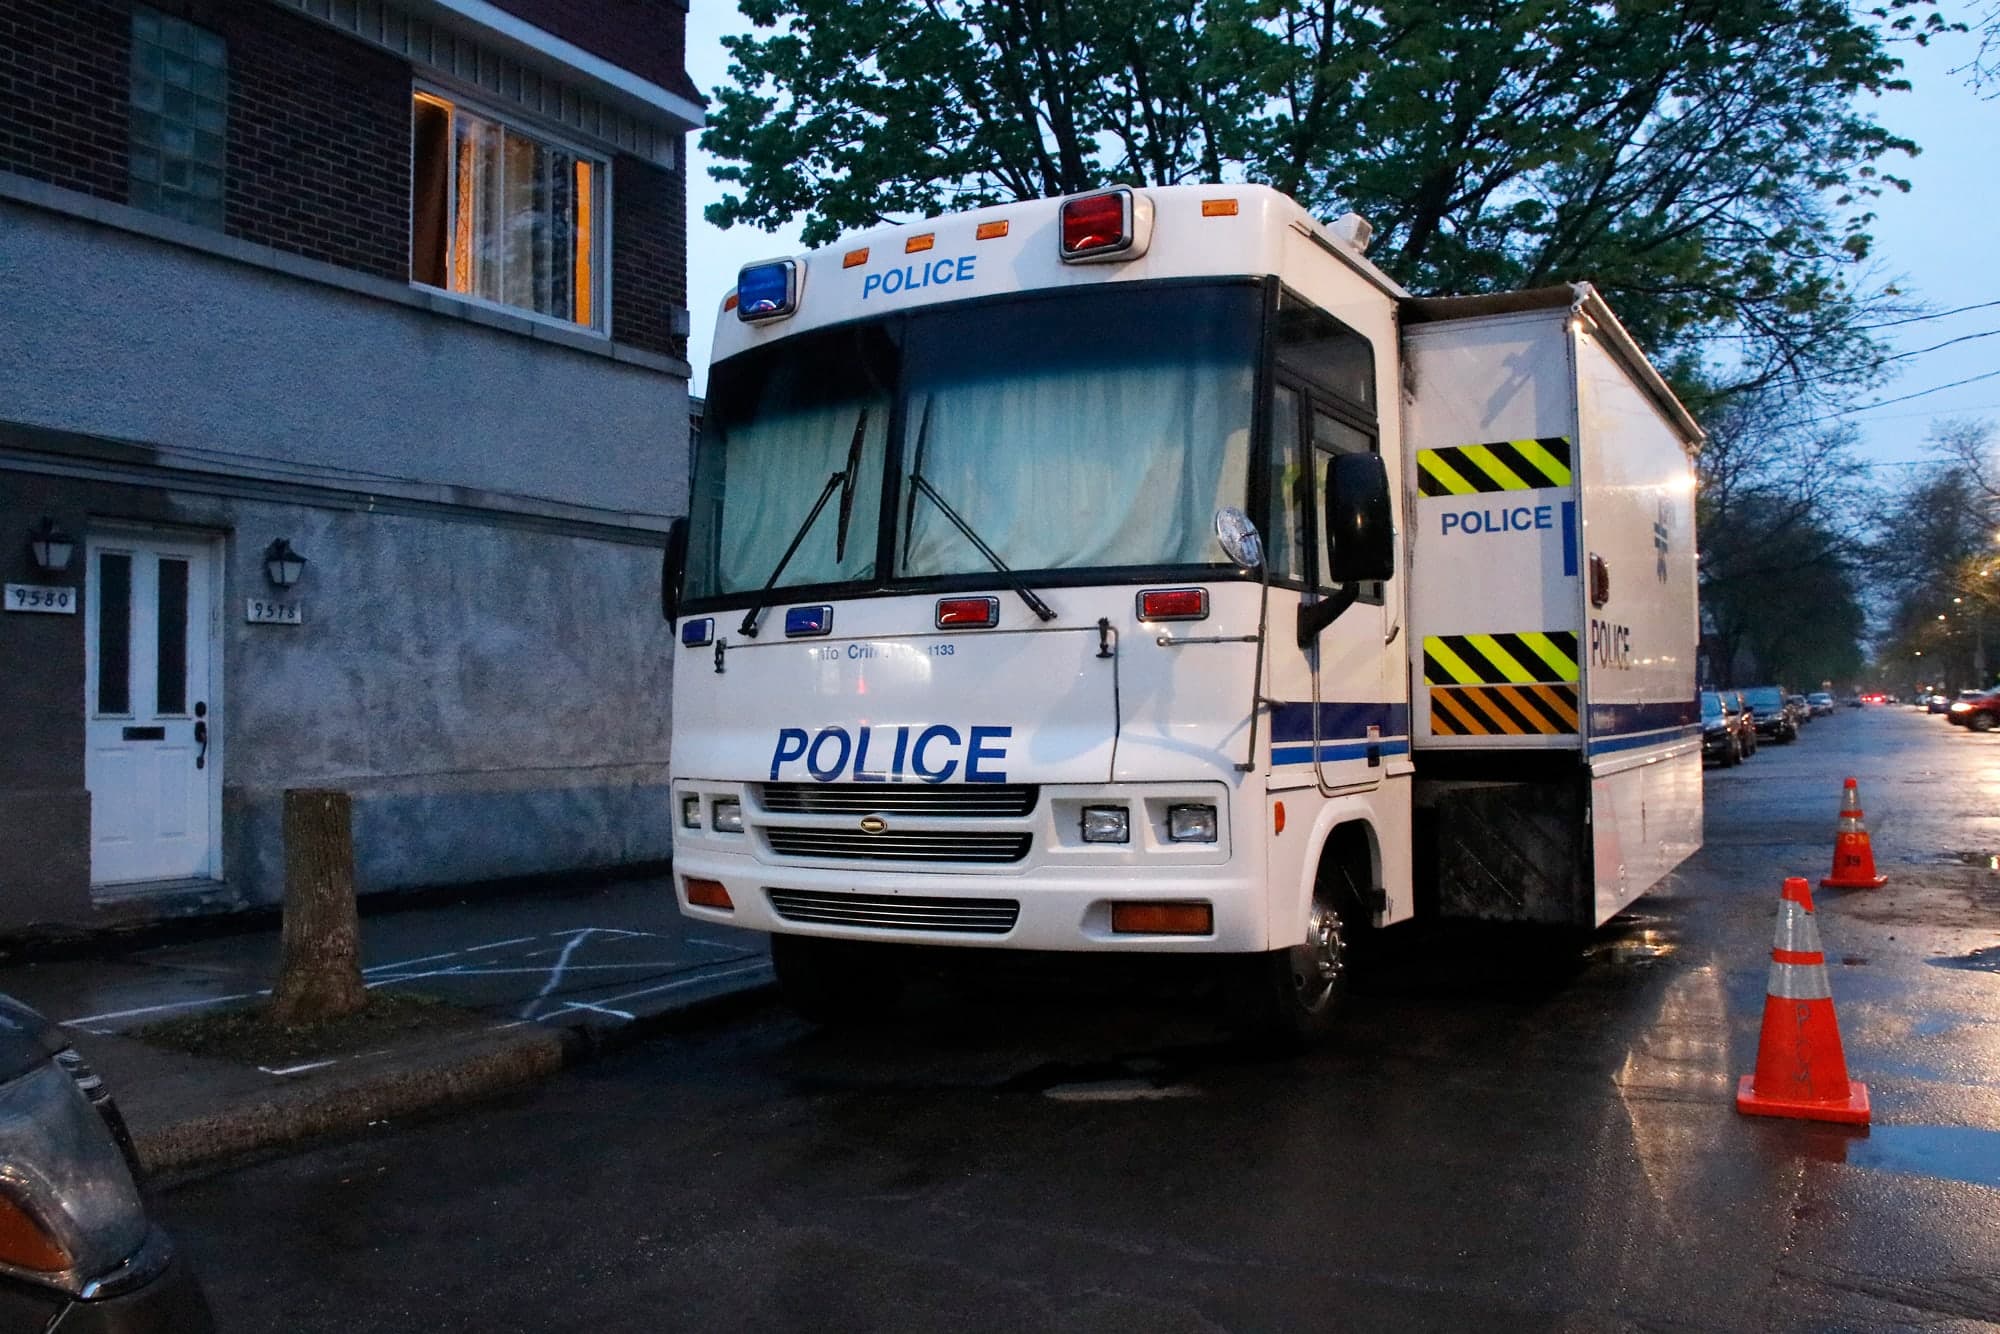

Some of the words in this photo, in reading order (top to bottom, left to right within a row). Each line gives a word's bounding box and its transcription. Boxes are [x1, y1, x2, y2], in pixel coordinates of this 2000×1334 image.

[863, 255, 977, 300] POLICE
[1441, 505, 1553, 536] POLICE
[15, 588, 68, 607] 9580
[255, 602, 295, 619] 9578
[1591, 618, 1630, 671] POLICE
[770, 724, 1013, 784] POLICE
